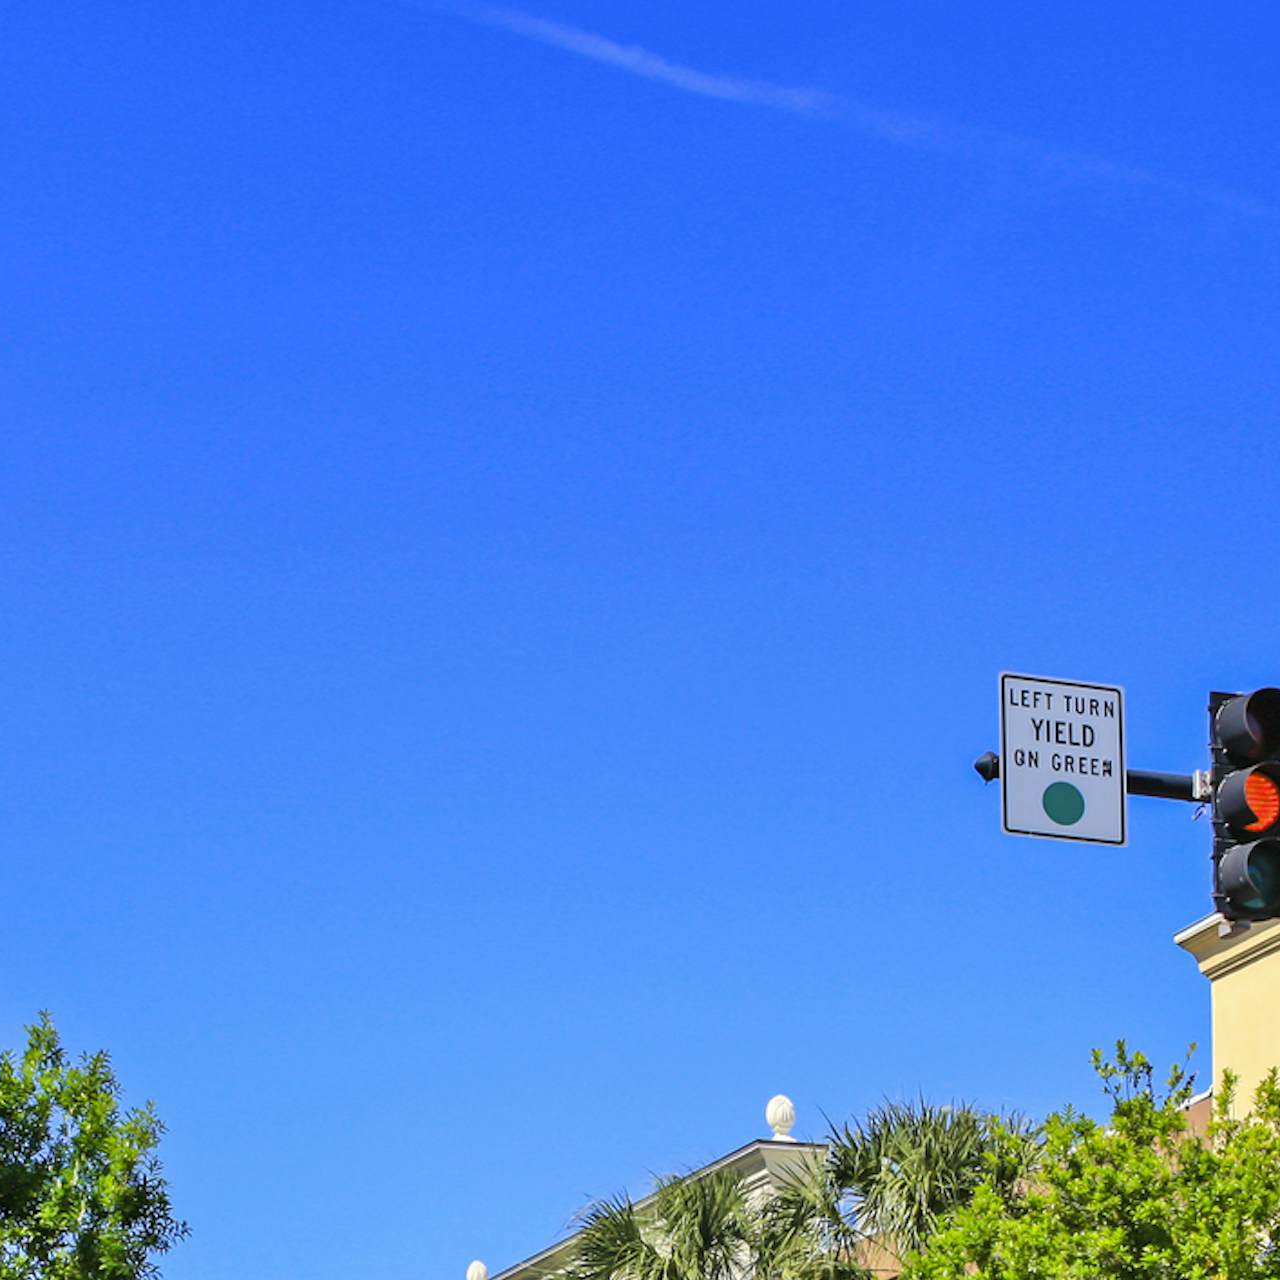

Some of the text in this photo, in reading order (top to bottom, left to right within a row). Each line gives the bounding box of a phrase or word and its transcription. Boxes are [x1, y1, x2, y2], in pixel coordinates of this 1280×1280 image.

[1009, 688, 1114, 718] LEFT TURN
[1031, 718, 1095, 747] YIELD
[1014, 749, 1113, 777] ON GREEN
